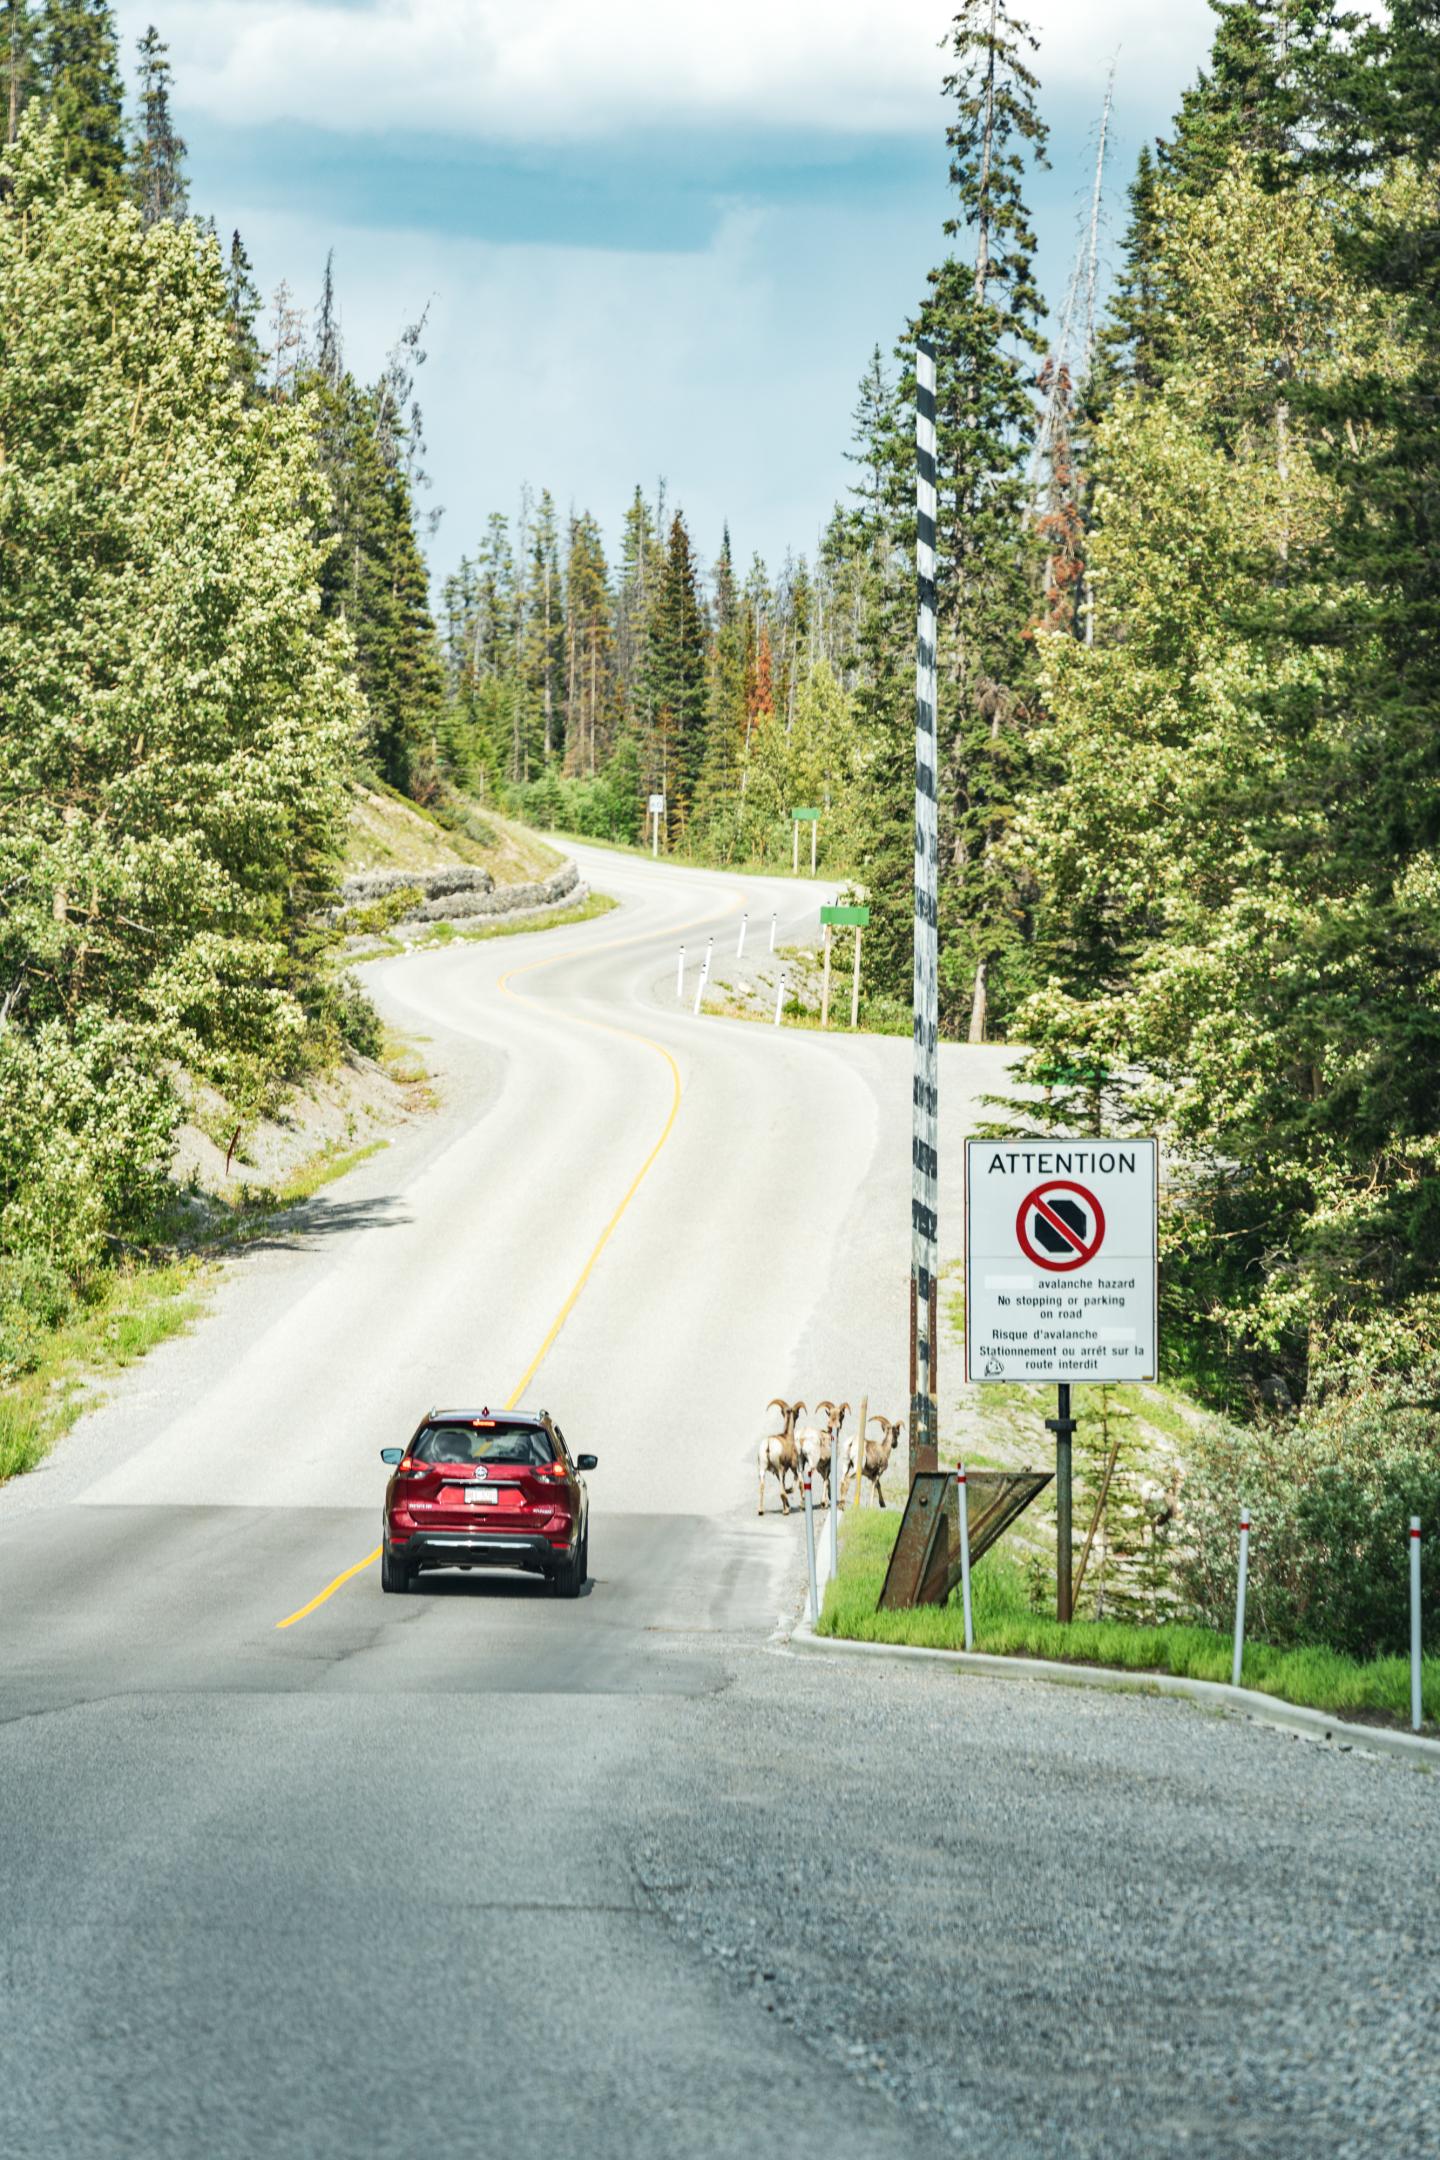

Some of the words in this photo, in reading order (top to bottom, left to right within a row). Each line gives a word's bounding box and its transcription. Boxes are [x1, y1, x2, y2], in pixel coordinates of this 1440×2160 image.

[988, 1153, 1135, 1173] ATTENTION
[1038, 1278, 1093, 1289] avalanche
[1098, 1278, 1135, 1289] hazard
[997, 1295, 1011, 1306] No
[1015, 1295, 1062, 1308] stopping
[1067, 1297, 1078, 1305] or
[1083, 1295, 1125, 1307] parking
[1040, 1310, 1053, 1319] on
[1058, 1308, 1083, 1319] road
[992, 1329, 1028, 1342] Risque
[1033, 1329, 1098, 1340] d'avalanche
[979, 1345, 1057, 1357] Stationnement
[1062, 1348, 1075, 1356] ou
[1111, 1347, 1129, 1356] sur
[1134, 1345, 1145, 1356] la
[1025, 1359, 1053, 1369] route
[1058, 1359, 1098, 1369] interdit
